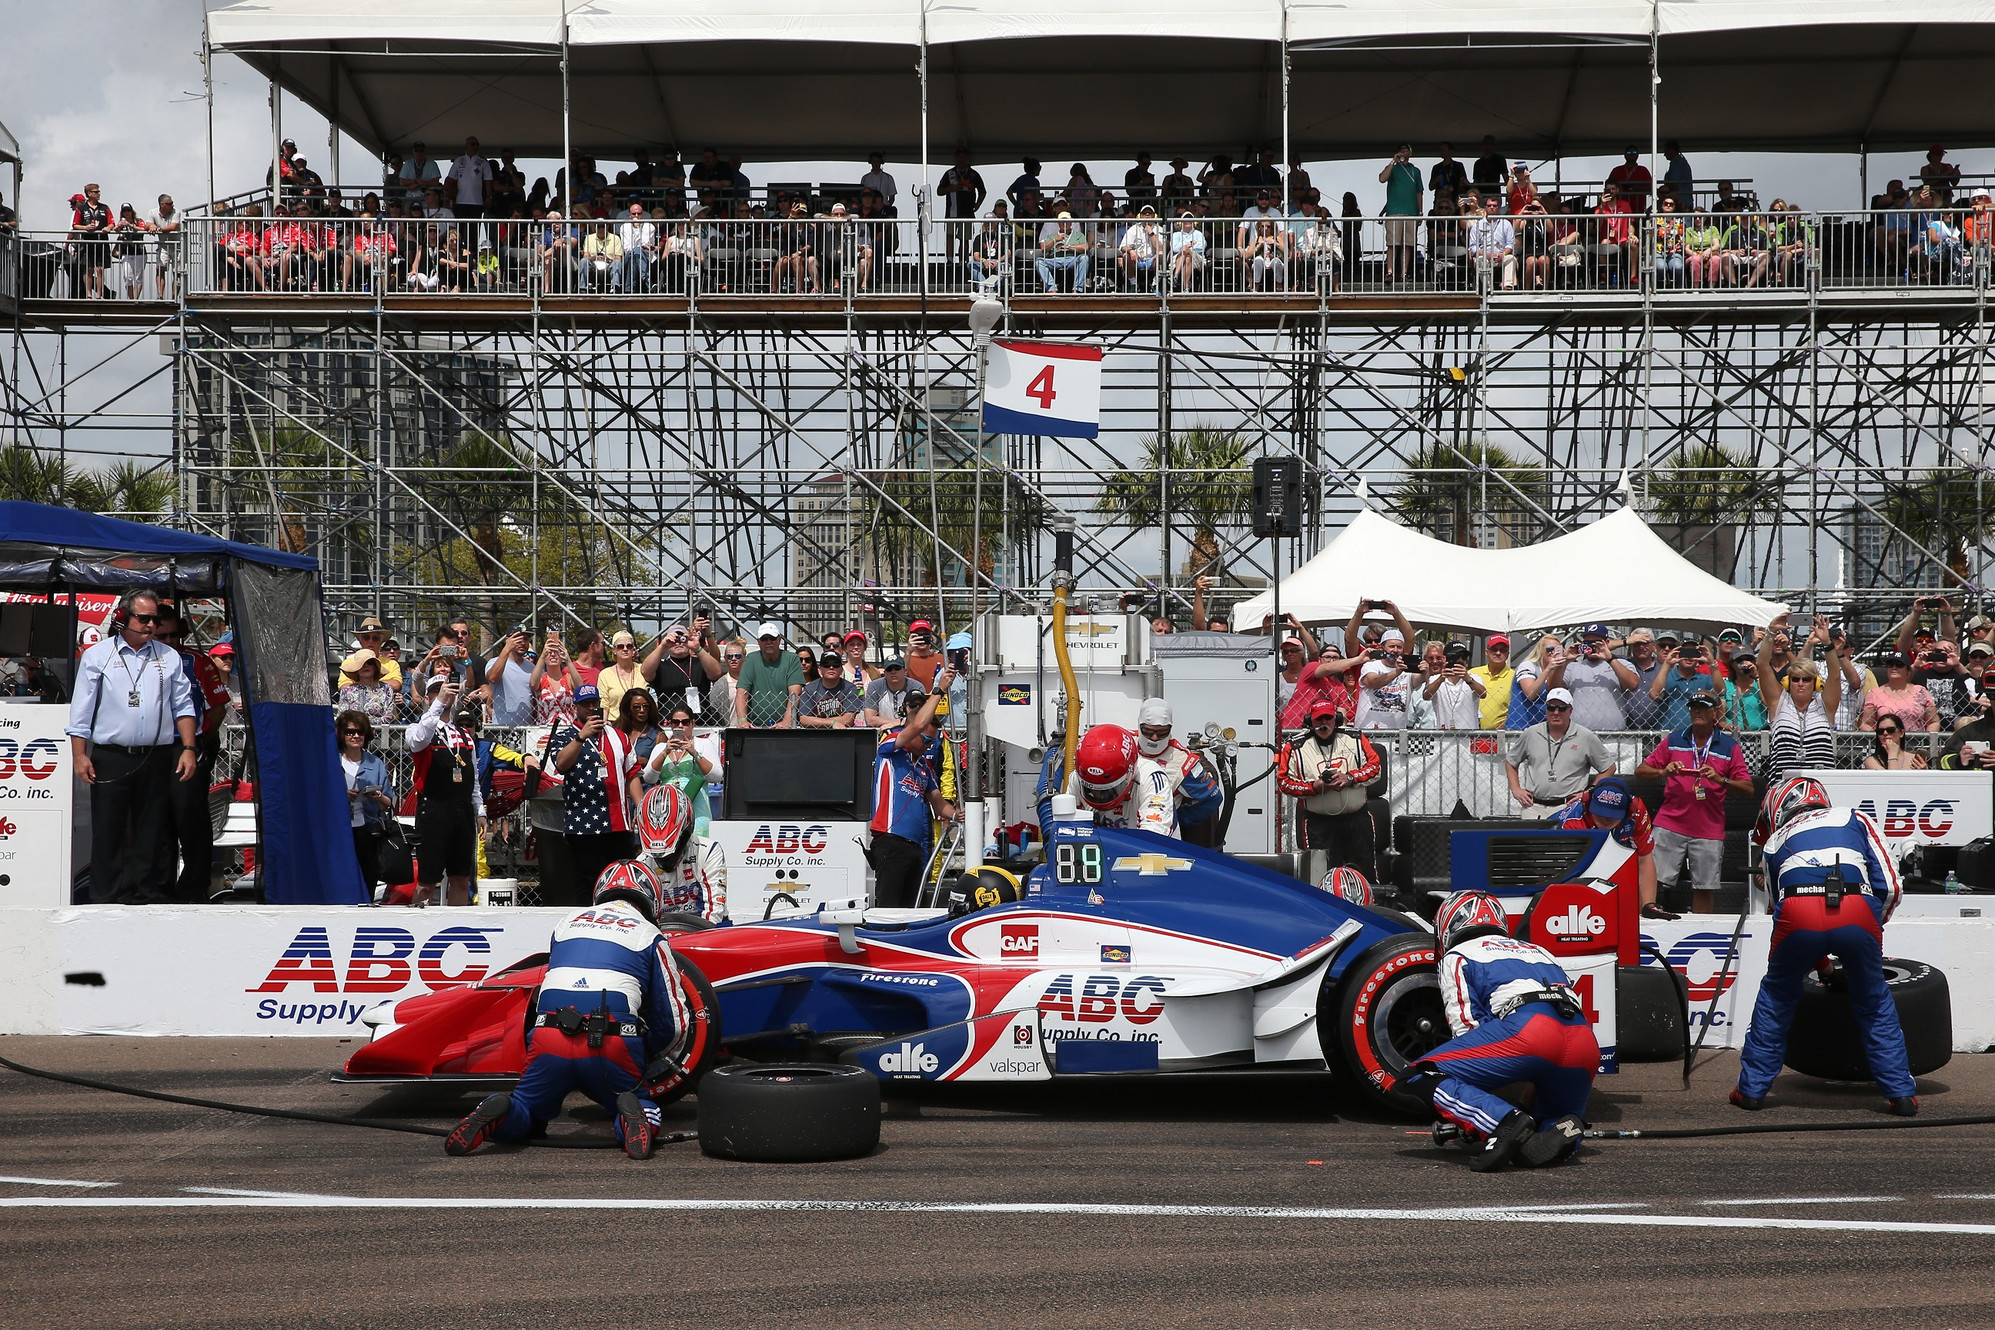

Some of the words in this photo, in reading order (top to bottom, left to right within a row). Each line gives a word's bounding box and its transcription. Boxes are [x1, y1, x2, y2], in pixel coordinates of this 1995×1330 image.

[1026, 365, 1056, 409] 4
[1120, 732, 1131, 761] ABC
[27, 786, 54, 799] inc.
[1597, 790, 1623, 803] ABC
[741, 824, 832, 854] ABC
[745, 856, 783, 867] Supply
[786, 856, 803, 866] Co.
[807, 856, 826, 866] inc.
[663, 881, 700, 906] ABC
[569, 910, 642, 928] ABC
[1546, 904, 1606, 935] alfe
[1001, 935, 1038, 951] GAF
[245, 926, 504, 993] ABC
[860, 973, 939, 987] Firestone
[1355, 952, 1435, 1027] Firestone
[256, 999, 366, 1025] Supply
[1036, 974, 1175, 1025] ABC
[1042, 1027, 1091, 1044] upply
[1096, 1028, 1120, 1041] Co
[878, 1042, 939, 1073] alfe
[990, 1058, 1041, 1076] valspar
